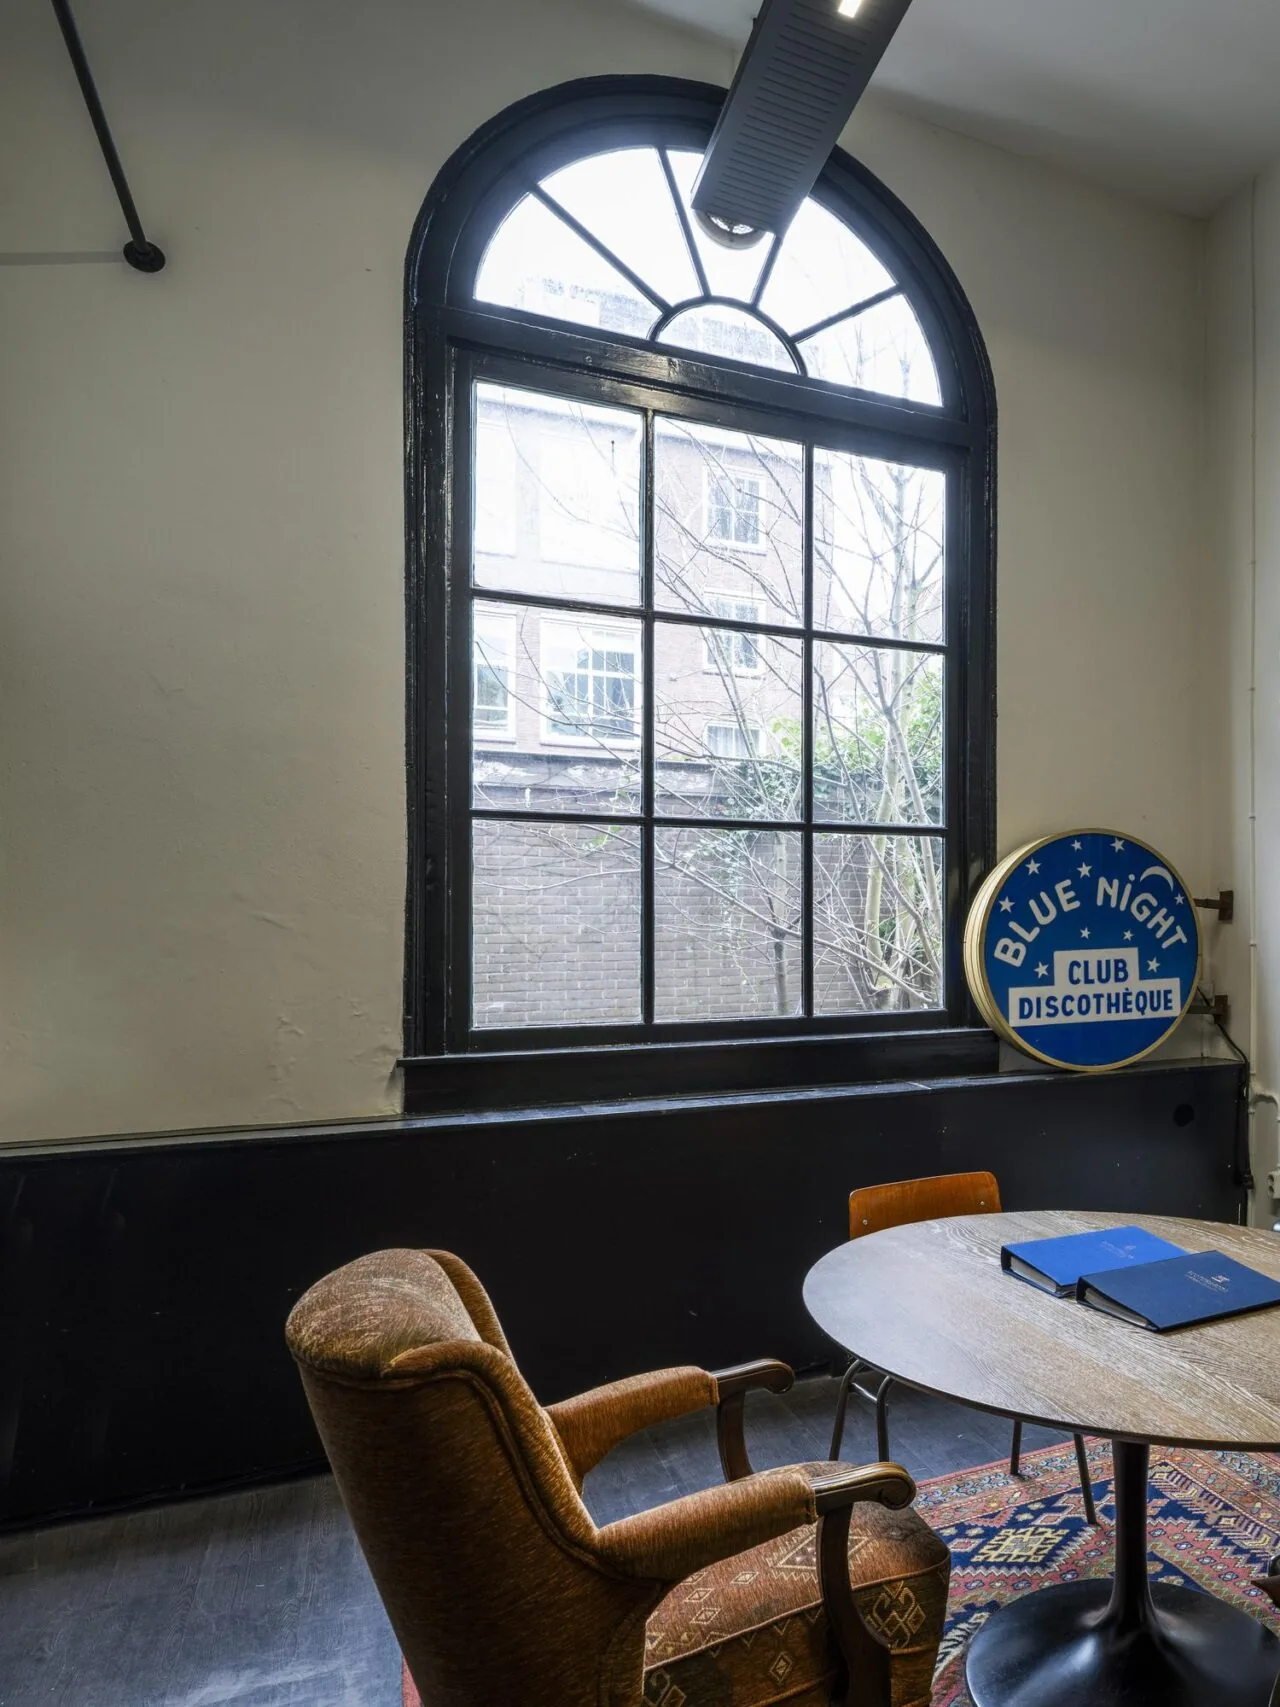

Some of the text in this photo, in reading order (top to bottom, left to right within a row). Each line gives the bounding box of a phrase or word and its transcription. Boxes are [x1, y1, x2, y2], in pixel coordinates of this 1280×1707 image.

[994, 879, 1081, 968] BLUE
[1068, 958, 1129, 985] CLUB
[1018, 988, 1173, 1021] DISCOTHÈQUE
